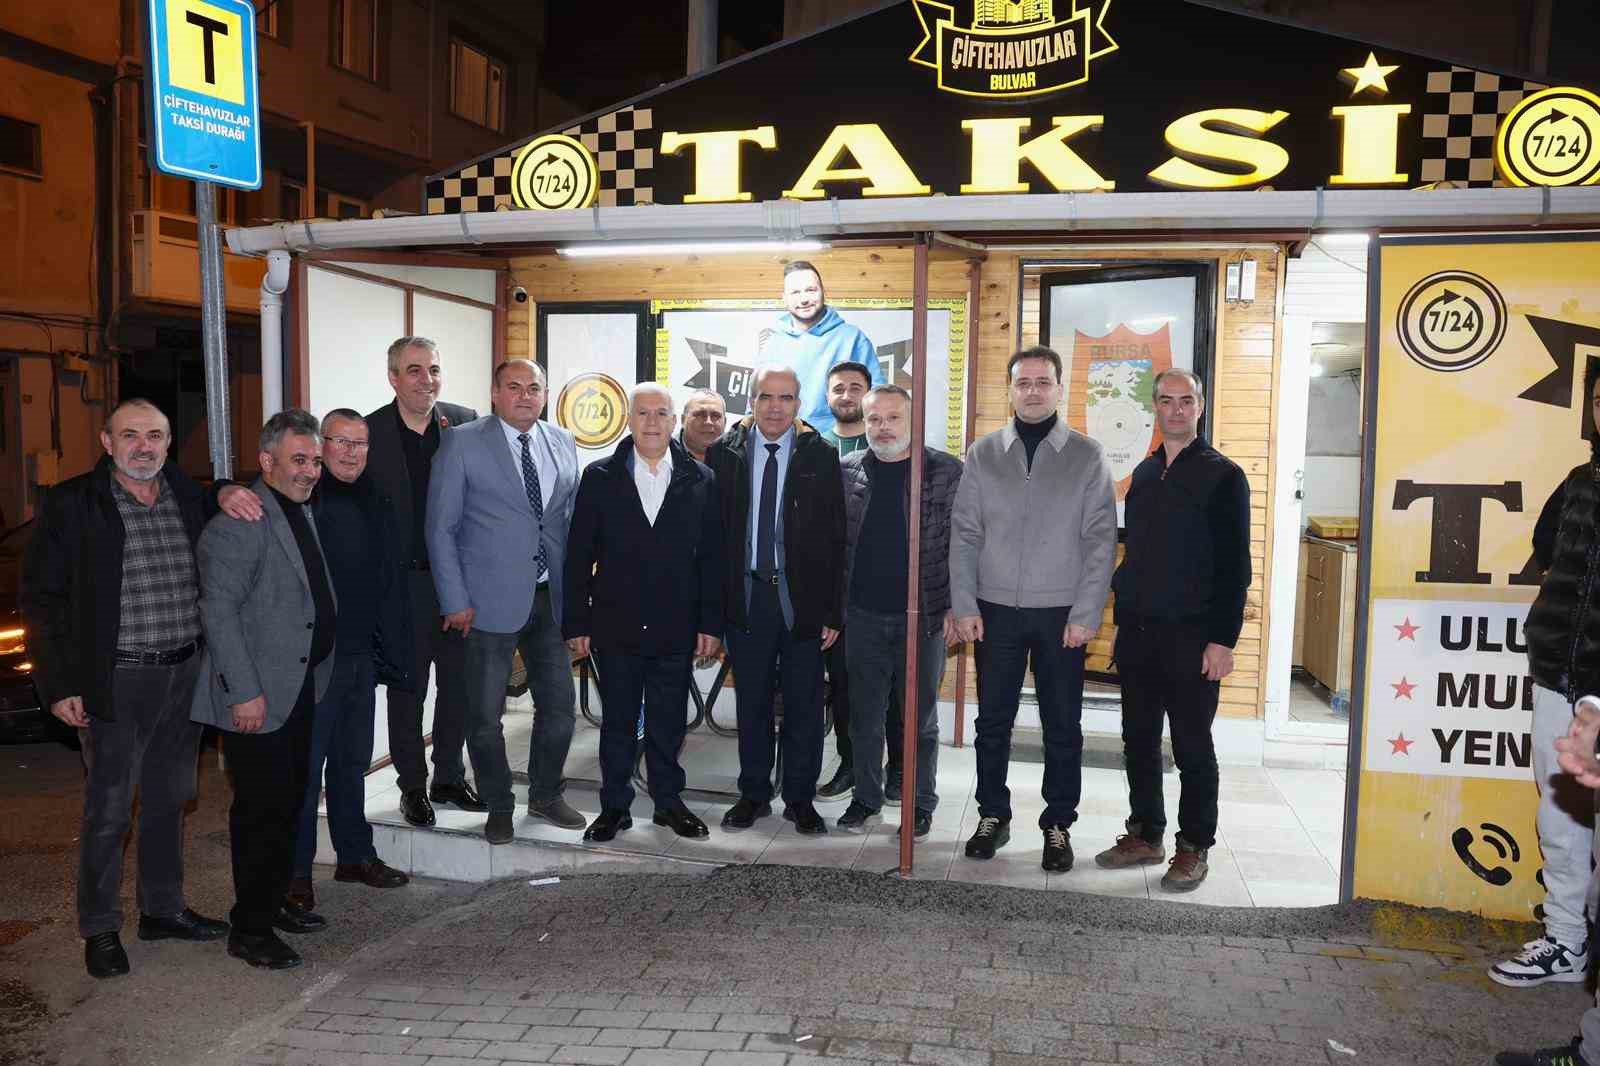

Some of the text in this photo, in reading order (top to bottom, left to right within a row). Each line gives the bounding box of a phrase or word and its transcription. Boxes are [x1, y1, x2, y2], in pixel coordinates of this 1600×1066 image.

[186, 10, 228, 85] T
[951, 28, 1077, 69] ÇİFTEHAVUZLAR
[990, 72, 1036, 91] BULVAR
[164, 94, 251, 127] ÇİFTEHAVUZLAR
[171, 113, 246, 141] TAKSİ DURAĞI
[1532, 133, 1581, 158] 7/24
[536, 174, 571, 193] 7/24
[1429, 310, 1475, 332] 7/24
[578, 402, 609, 419] 7/24
